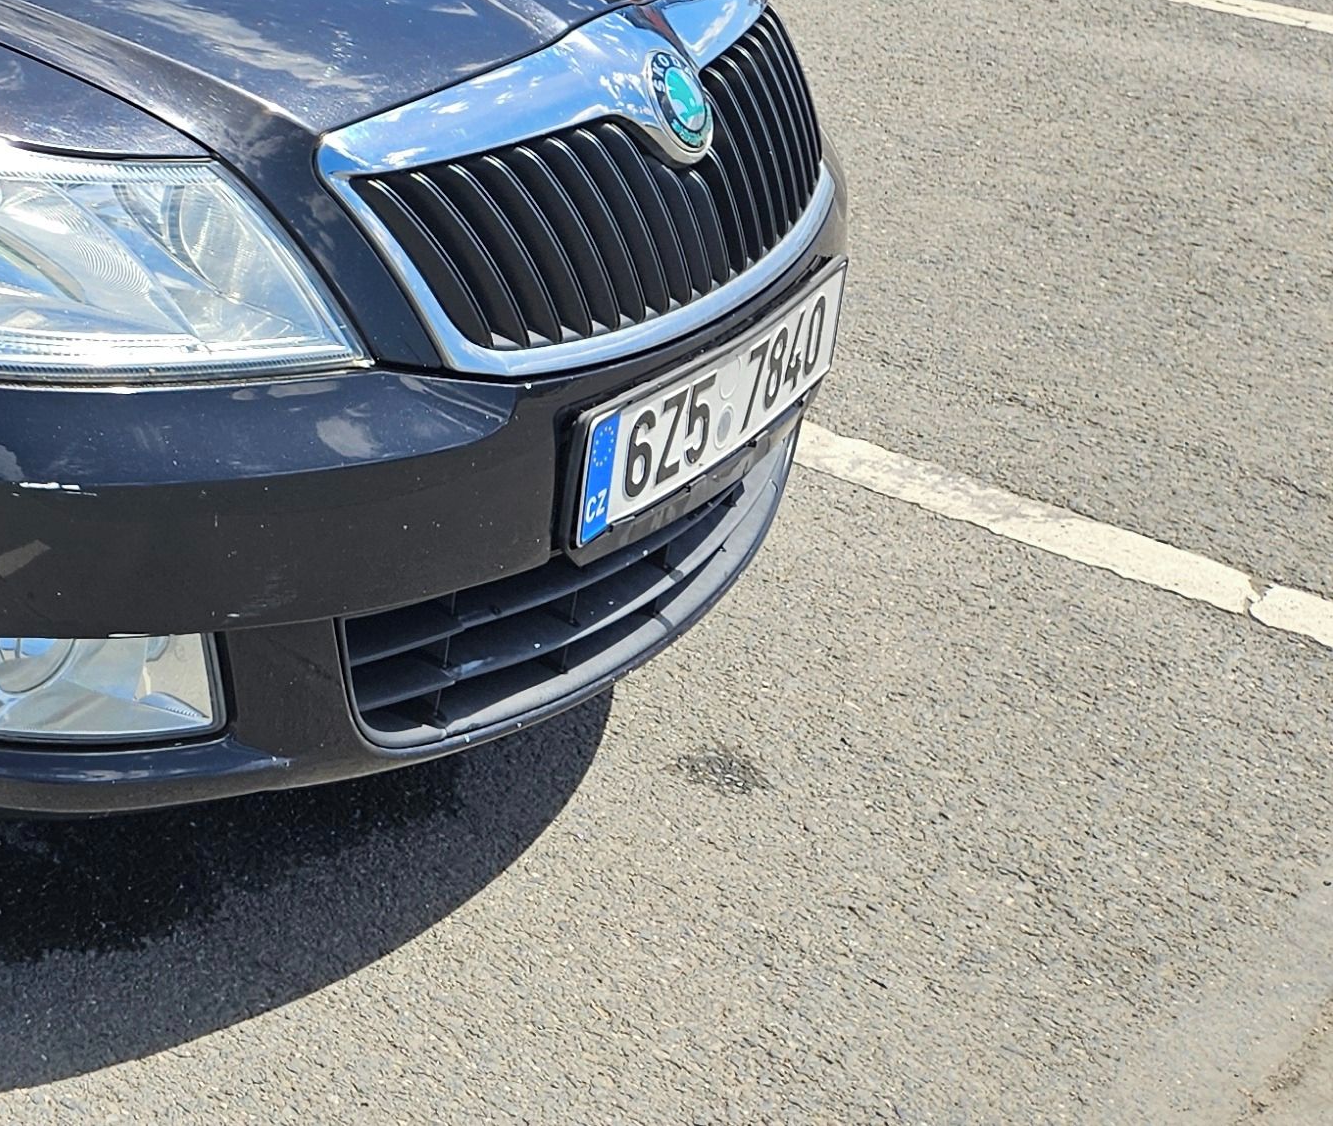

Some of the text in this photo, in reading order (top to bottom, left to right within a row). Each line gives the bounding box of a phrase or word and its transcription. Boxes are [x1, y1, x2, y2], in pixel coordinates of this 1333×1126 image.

[623, 294, 827, 499] 6Z5 7840
[585, 487, 608, 524] CZ
